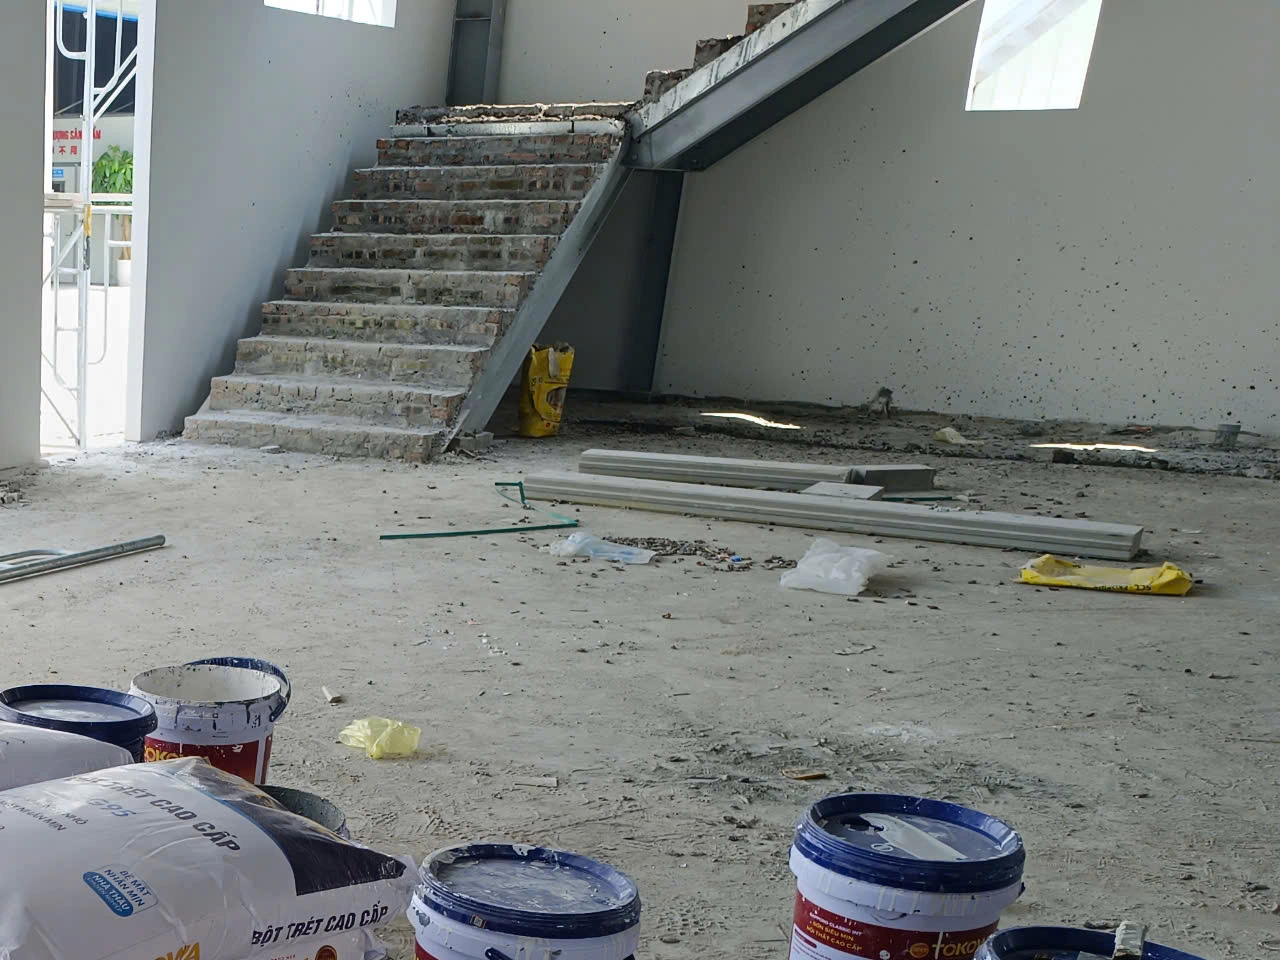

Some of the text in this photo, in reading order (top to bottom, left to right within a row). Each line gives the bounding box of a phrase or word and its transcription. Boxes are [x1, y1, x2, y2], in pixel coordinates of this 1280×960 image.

[150, 799, 241, 851] CAO CẤP
[251, 900, 389, 947] BỘT TRÉT CAO CẤP
[830, 938, 845, 947] CAO
